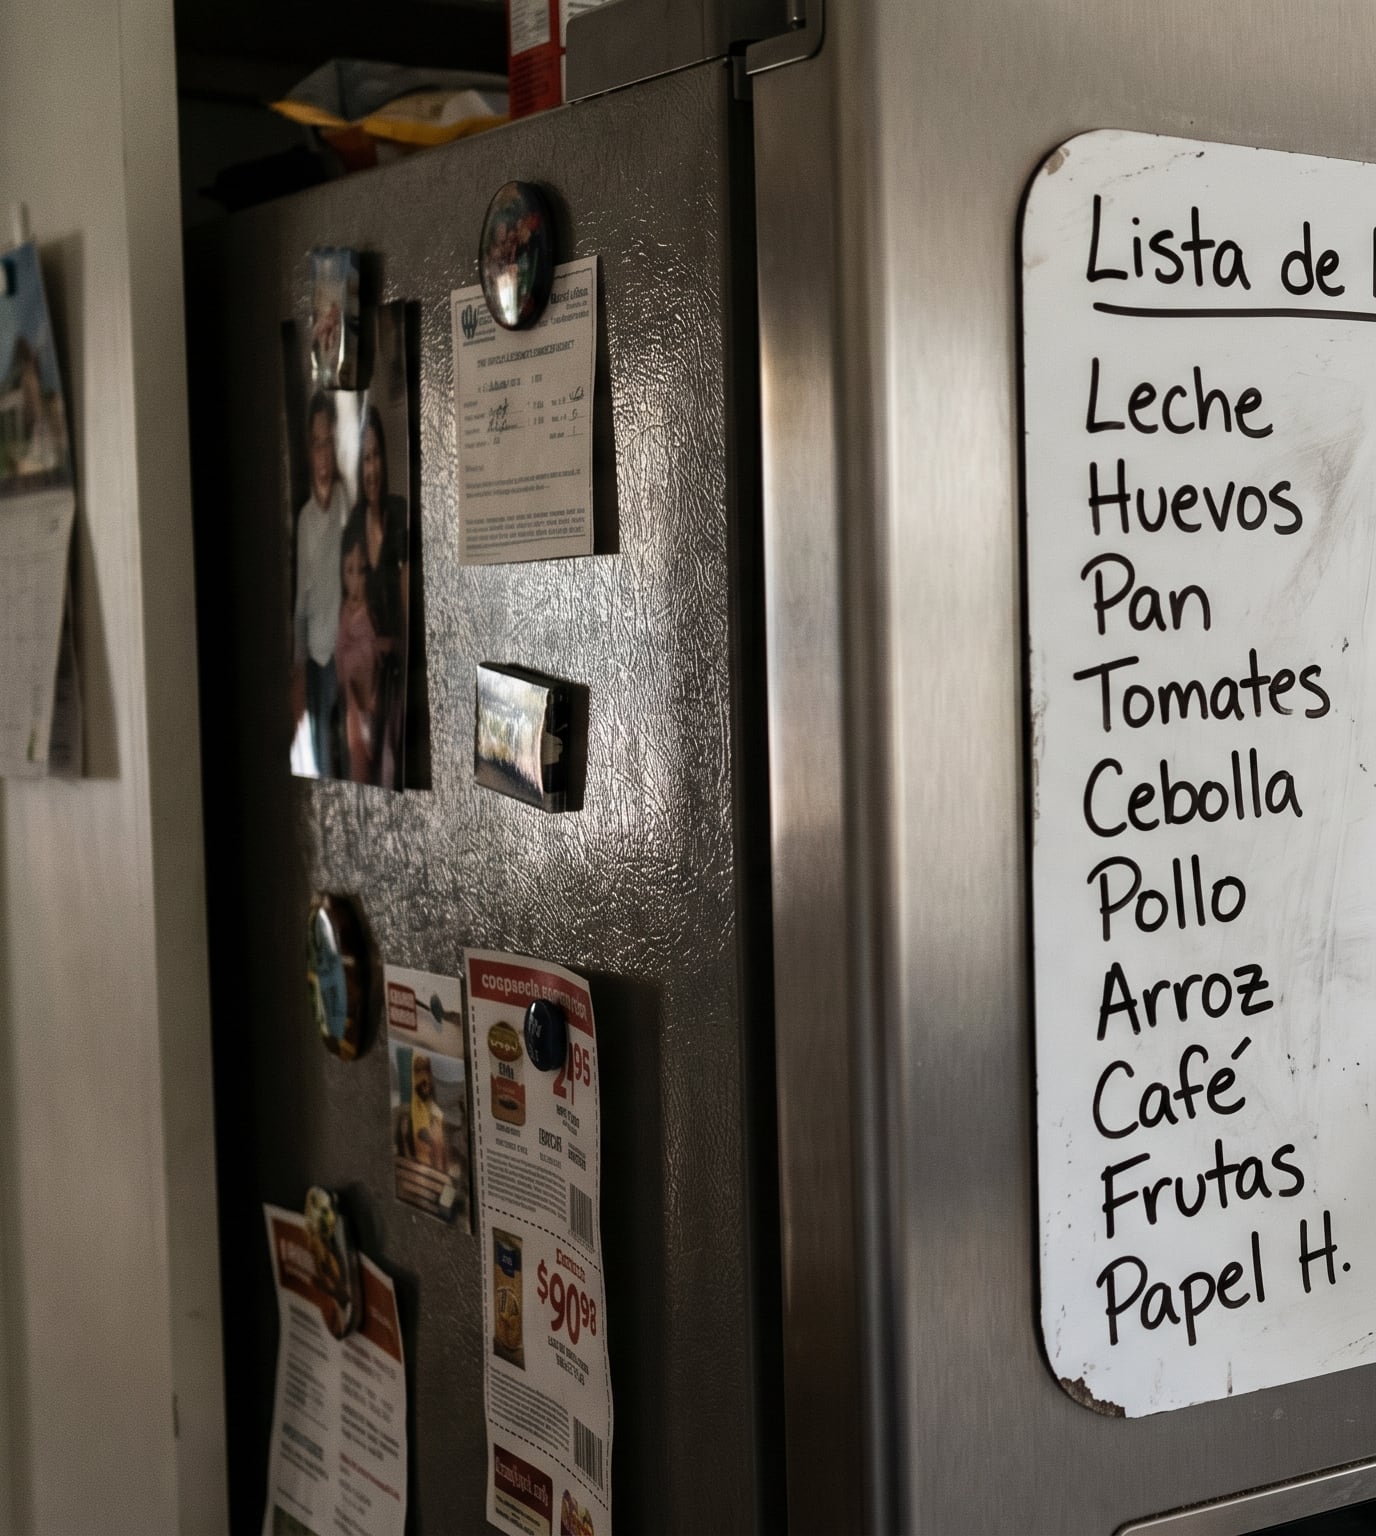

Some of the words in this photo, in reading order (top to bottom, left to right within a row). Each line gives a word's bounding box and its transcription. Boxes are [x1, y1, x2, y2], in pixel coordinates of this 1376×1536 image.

[1086, 194, 1252, 291] Lista
[1280, 221, 1346, 297] de
[1086, 357, 1274, 439] Leche
[1089, 458, 1303, 536] Huevos
[1081, 552, 1211, 636] Pan
[1073, 648, 1331, 733] Tomates
[1083, 747, 1303, 838] Cebolla
[1087, 854, 1247, 941] Pollo
[1096, 962, 1274, 1040] Arroz
[1093, 1037, 1252, 1139] Café
[1101, 1138, 1306, 1239] Frutas
[1096, 1231, 1266, 1346] Papel
[1298, 1209, 1352, 1294] H.
